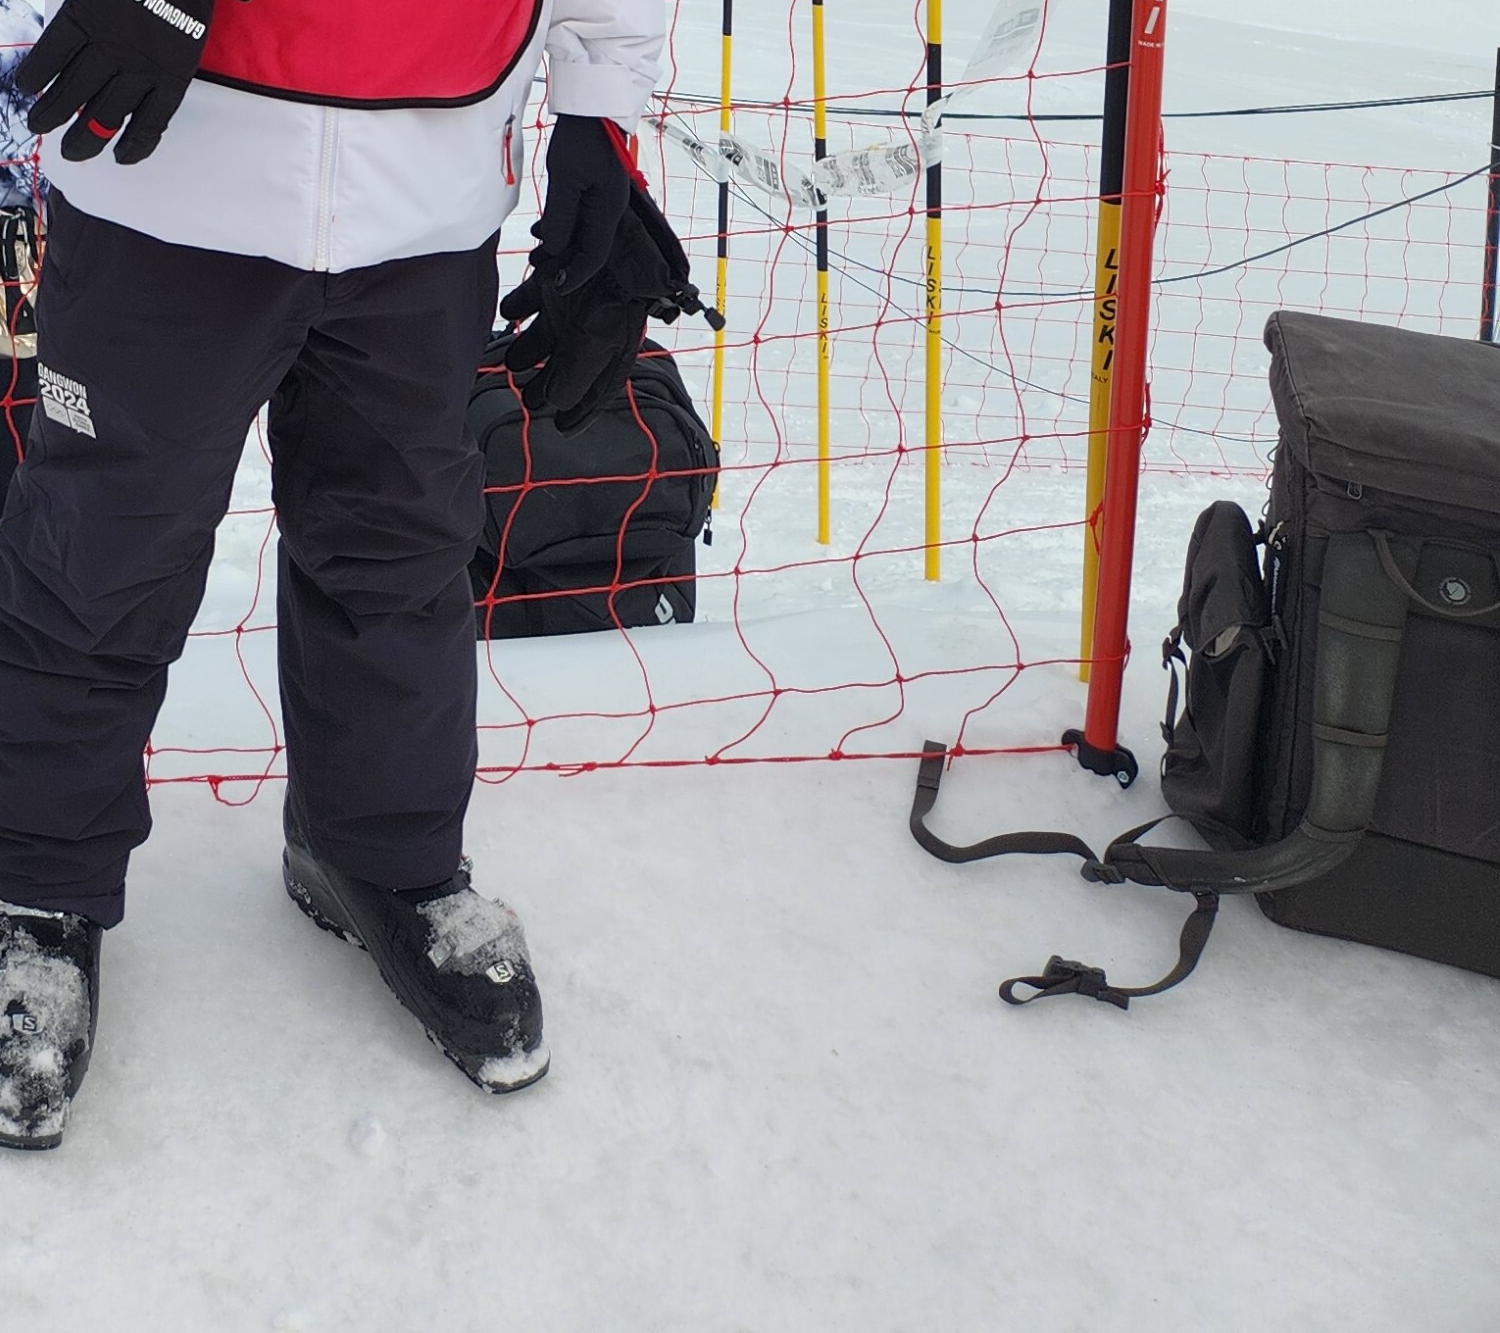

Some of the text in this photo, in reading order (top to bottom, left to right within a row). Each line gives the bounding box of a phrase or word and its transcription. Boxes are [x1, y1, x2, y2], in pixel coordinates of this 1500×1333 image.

[927, 246, 937, 325] LISKI
[1099, 249, 1118, 370] LISKI
[819, 293, 829, 352] LISKI
[38, 362, 88, 399] GANGWON
[39, 378, 91, 416] 2024
